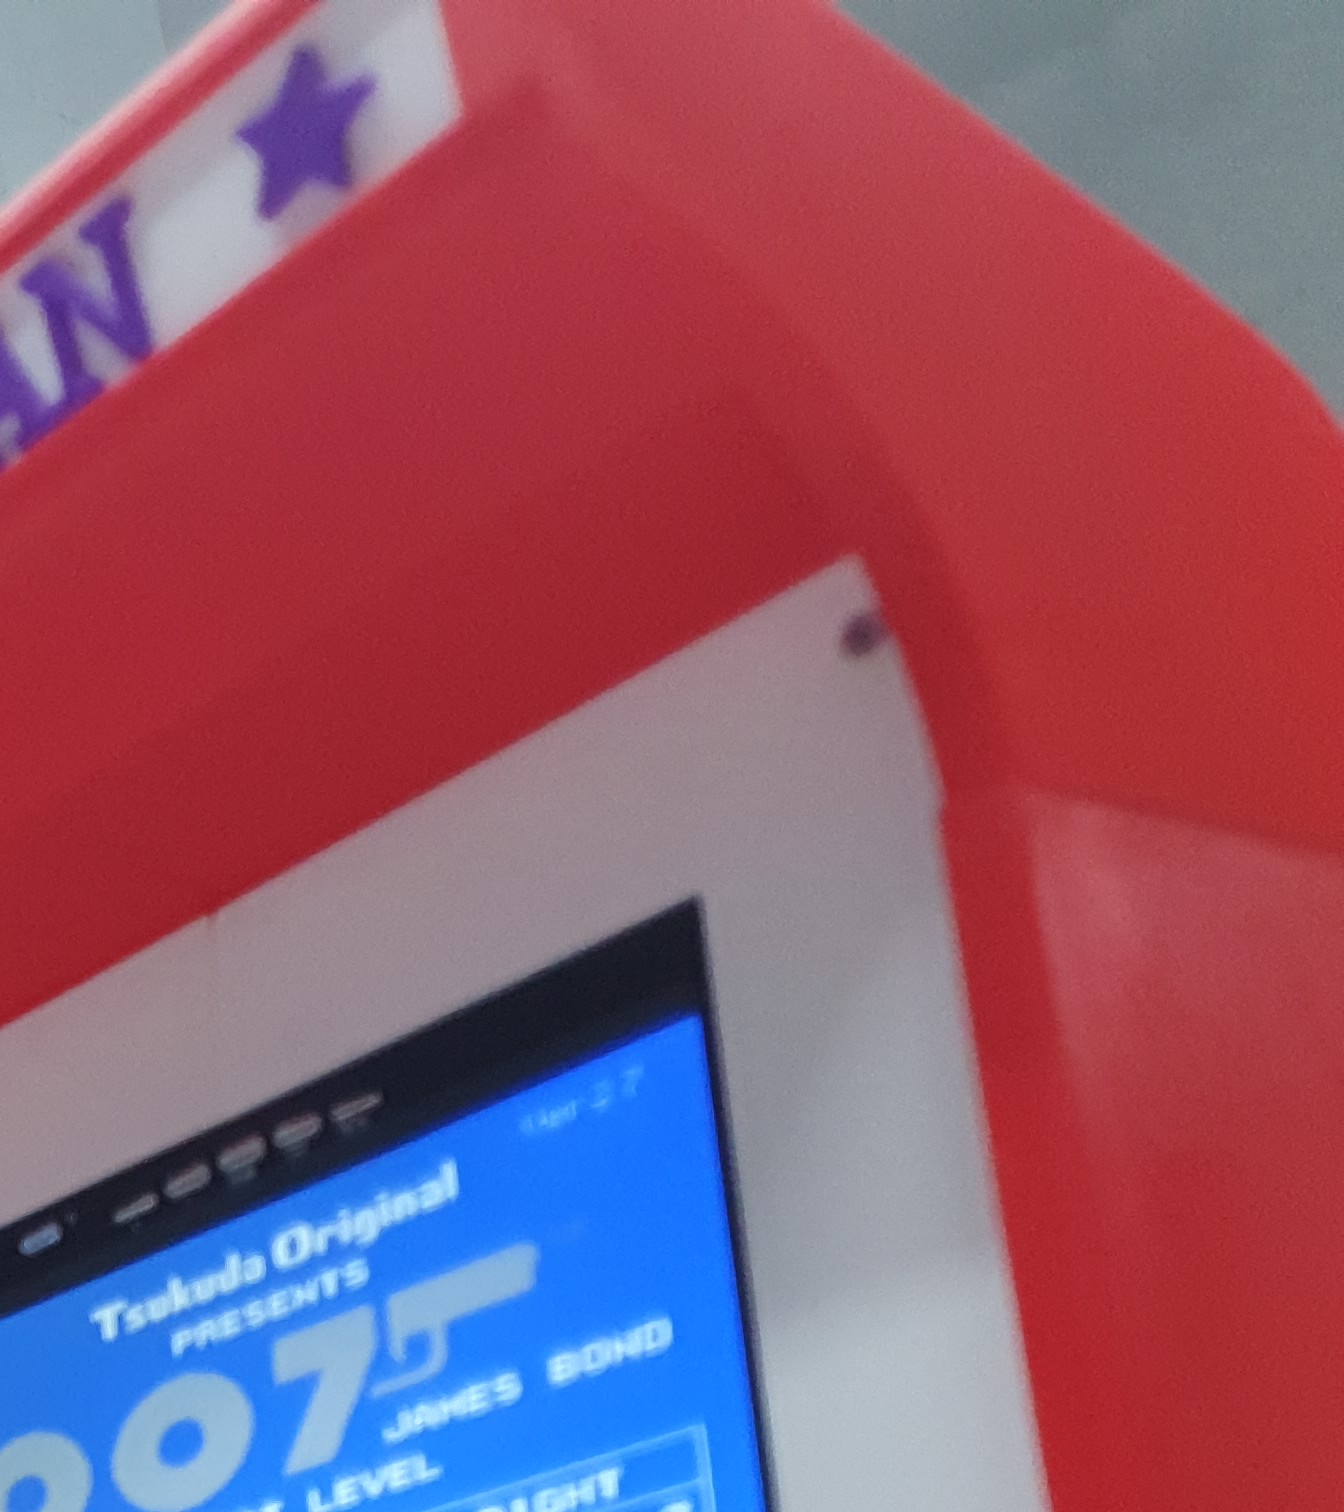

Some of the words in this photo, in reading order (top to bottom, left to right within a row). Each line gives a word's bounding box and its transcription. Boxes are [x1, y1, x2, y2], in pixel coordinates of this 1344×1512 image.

[89, 1250, 267, 1343] Tsukuda
[269, 1157, 460, 1270] Original
[170, 1257, 370, 1358] PRESENTS
[381, 1370, 524, 1444] JAMES
[546, 1315, 674, 1388] BOND
